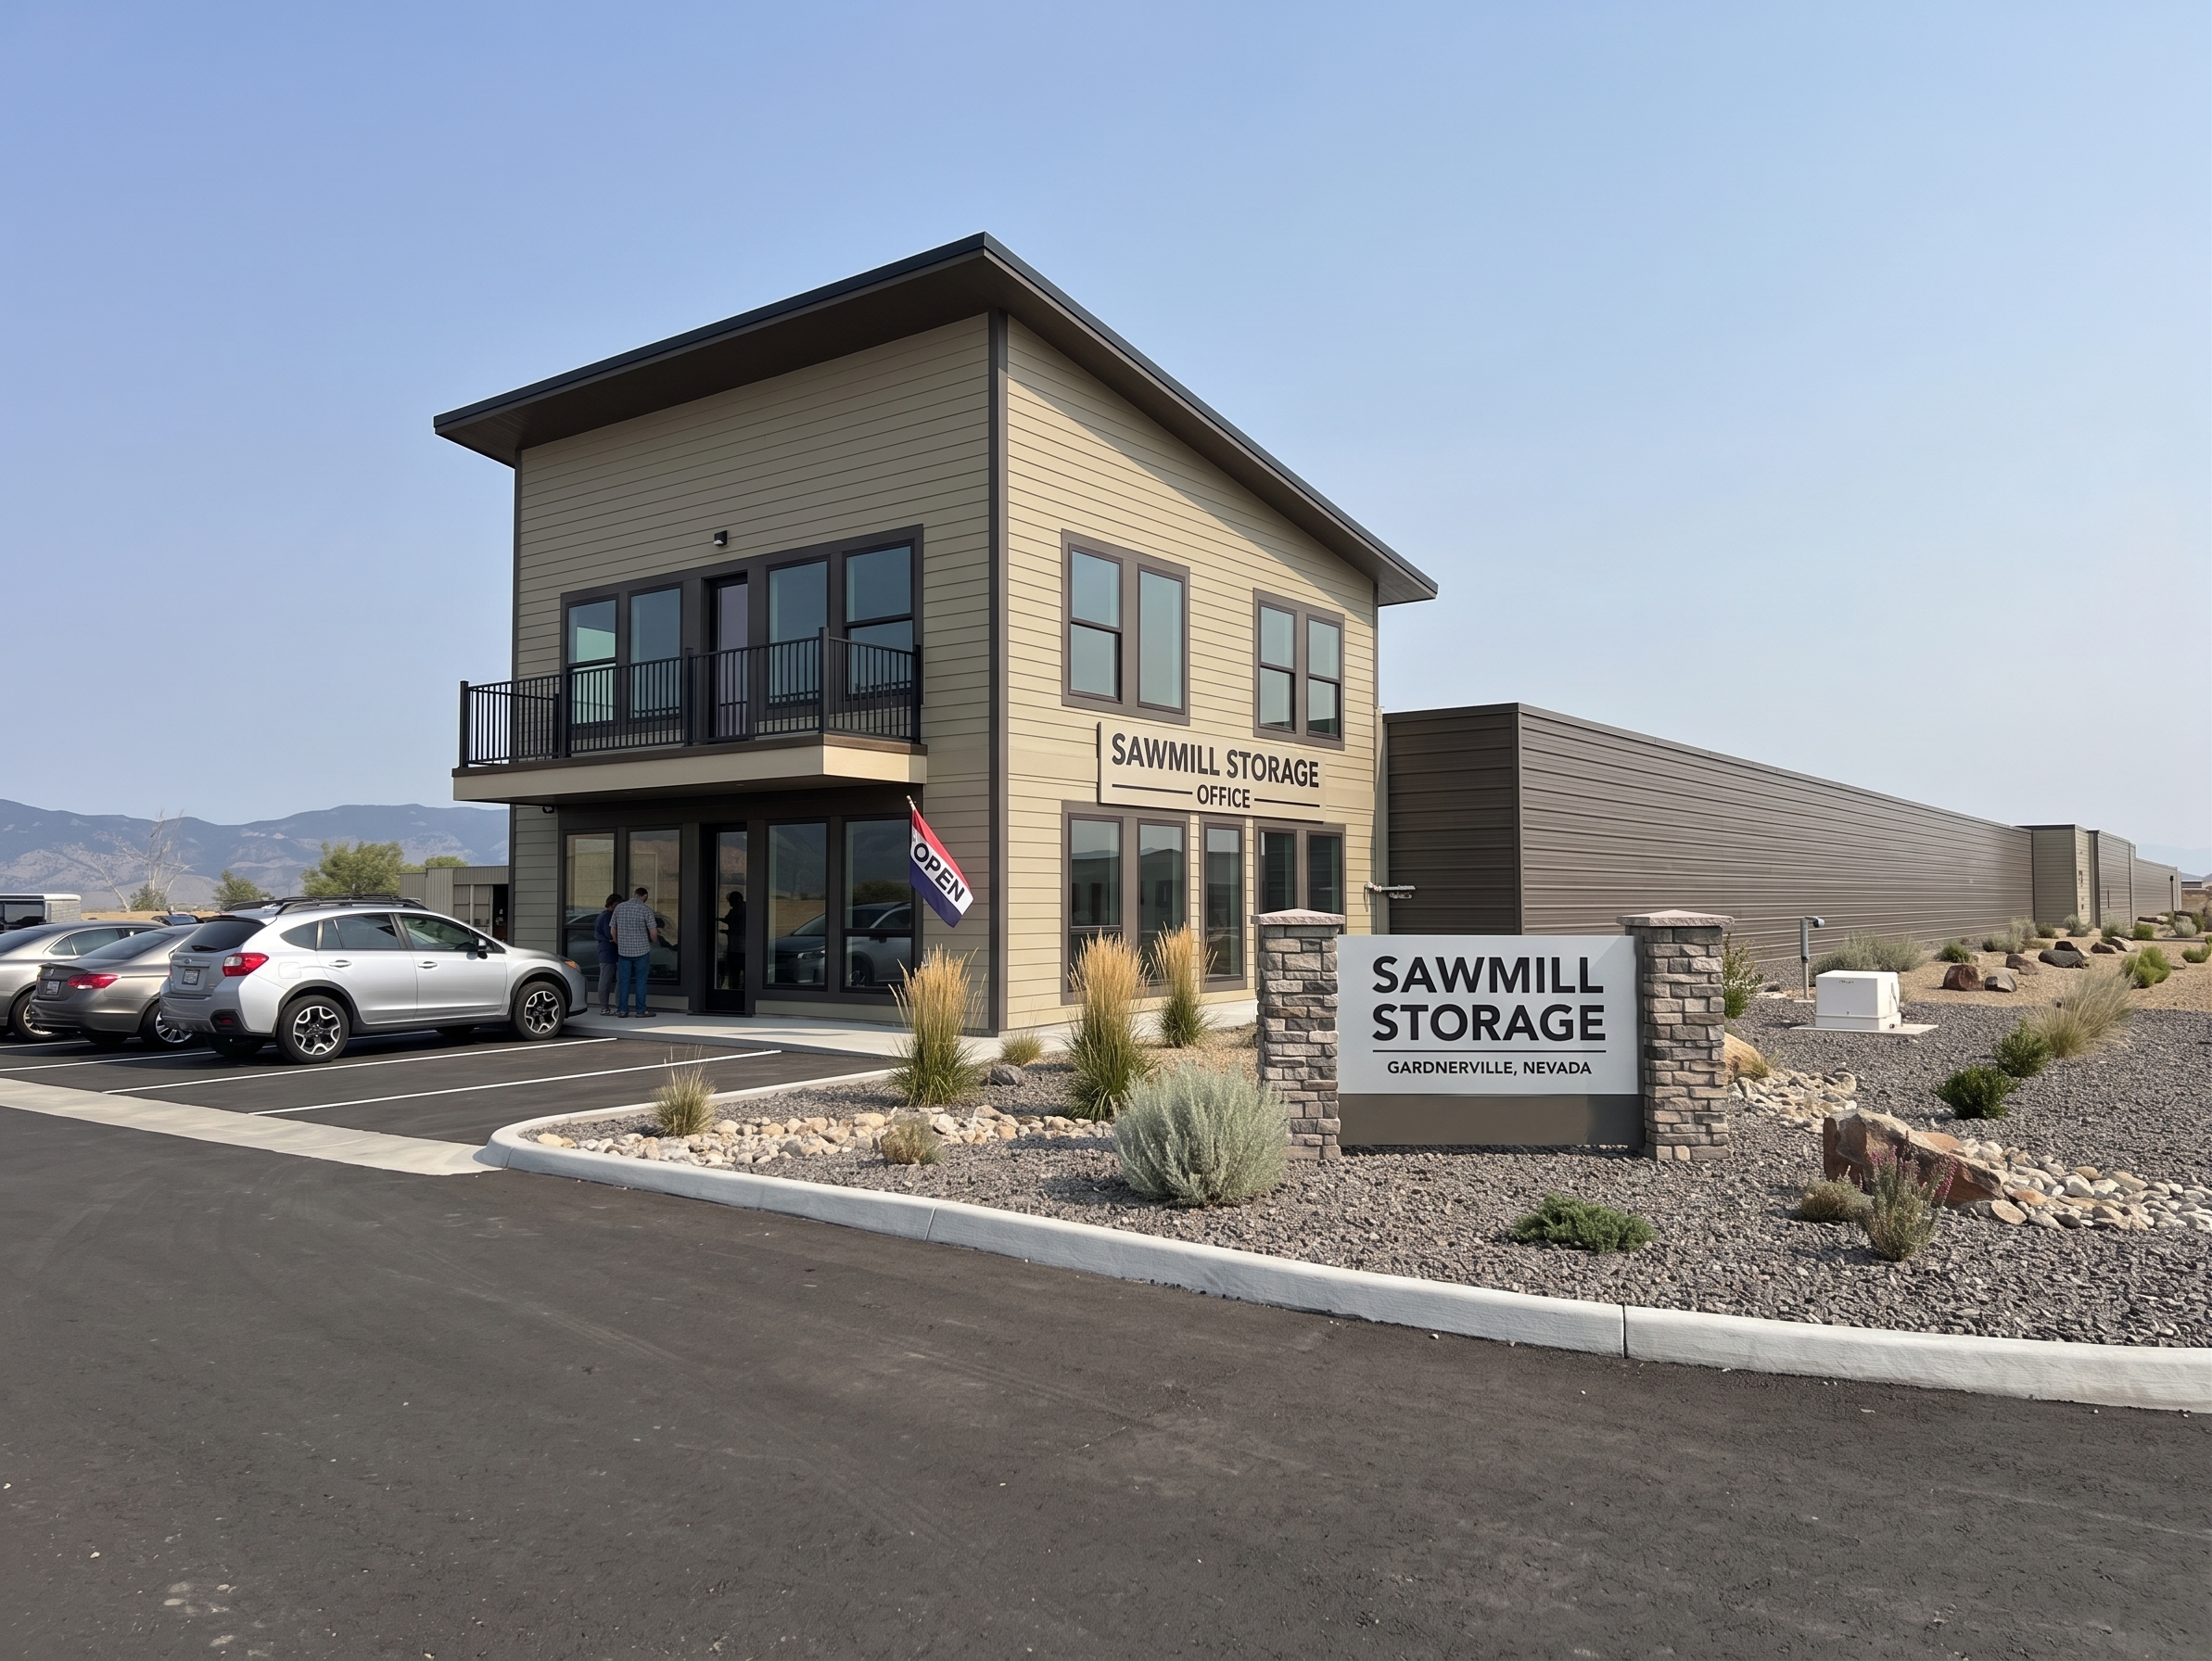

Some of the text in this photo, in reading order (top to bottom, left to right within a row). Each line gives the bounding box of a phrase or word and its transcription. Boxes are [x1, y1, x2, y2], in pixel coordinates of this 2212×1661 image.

[1112, 732, 1320, 789] SAWMILL STORAGE
[1197, 784, 1251, 809] OFFICE
[913, 843, 965, 903] OPEN
[1372, 955, 1604, 994] SAWMILL
[1371, 1003, 1607, 1042] STORAGE
[1387, 1060, 1593, 1076] GARDNERVILLE, NEVADA
